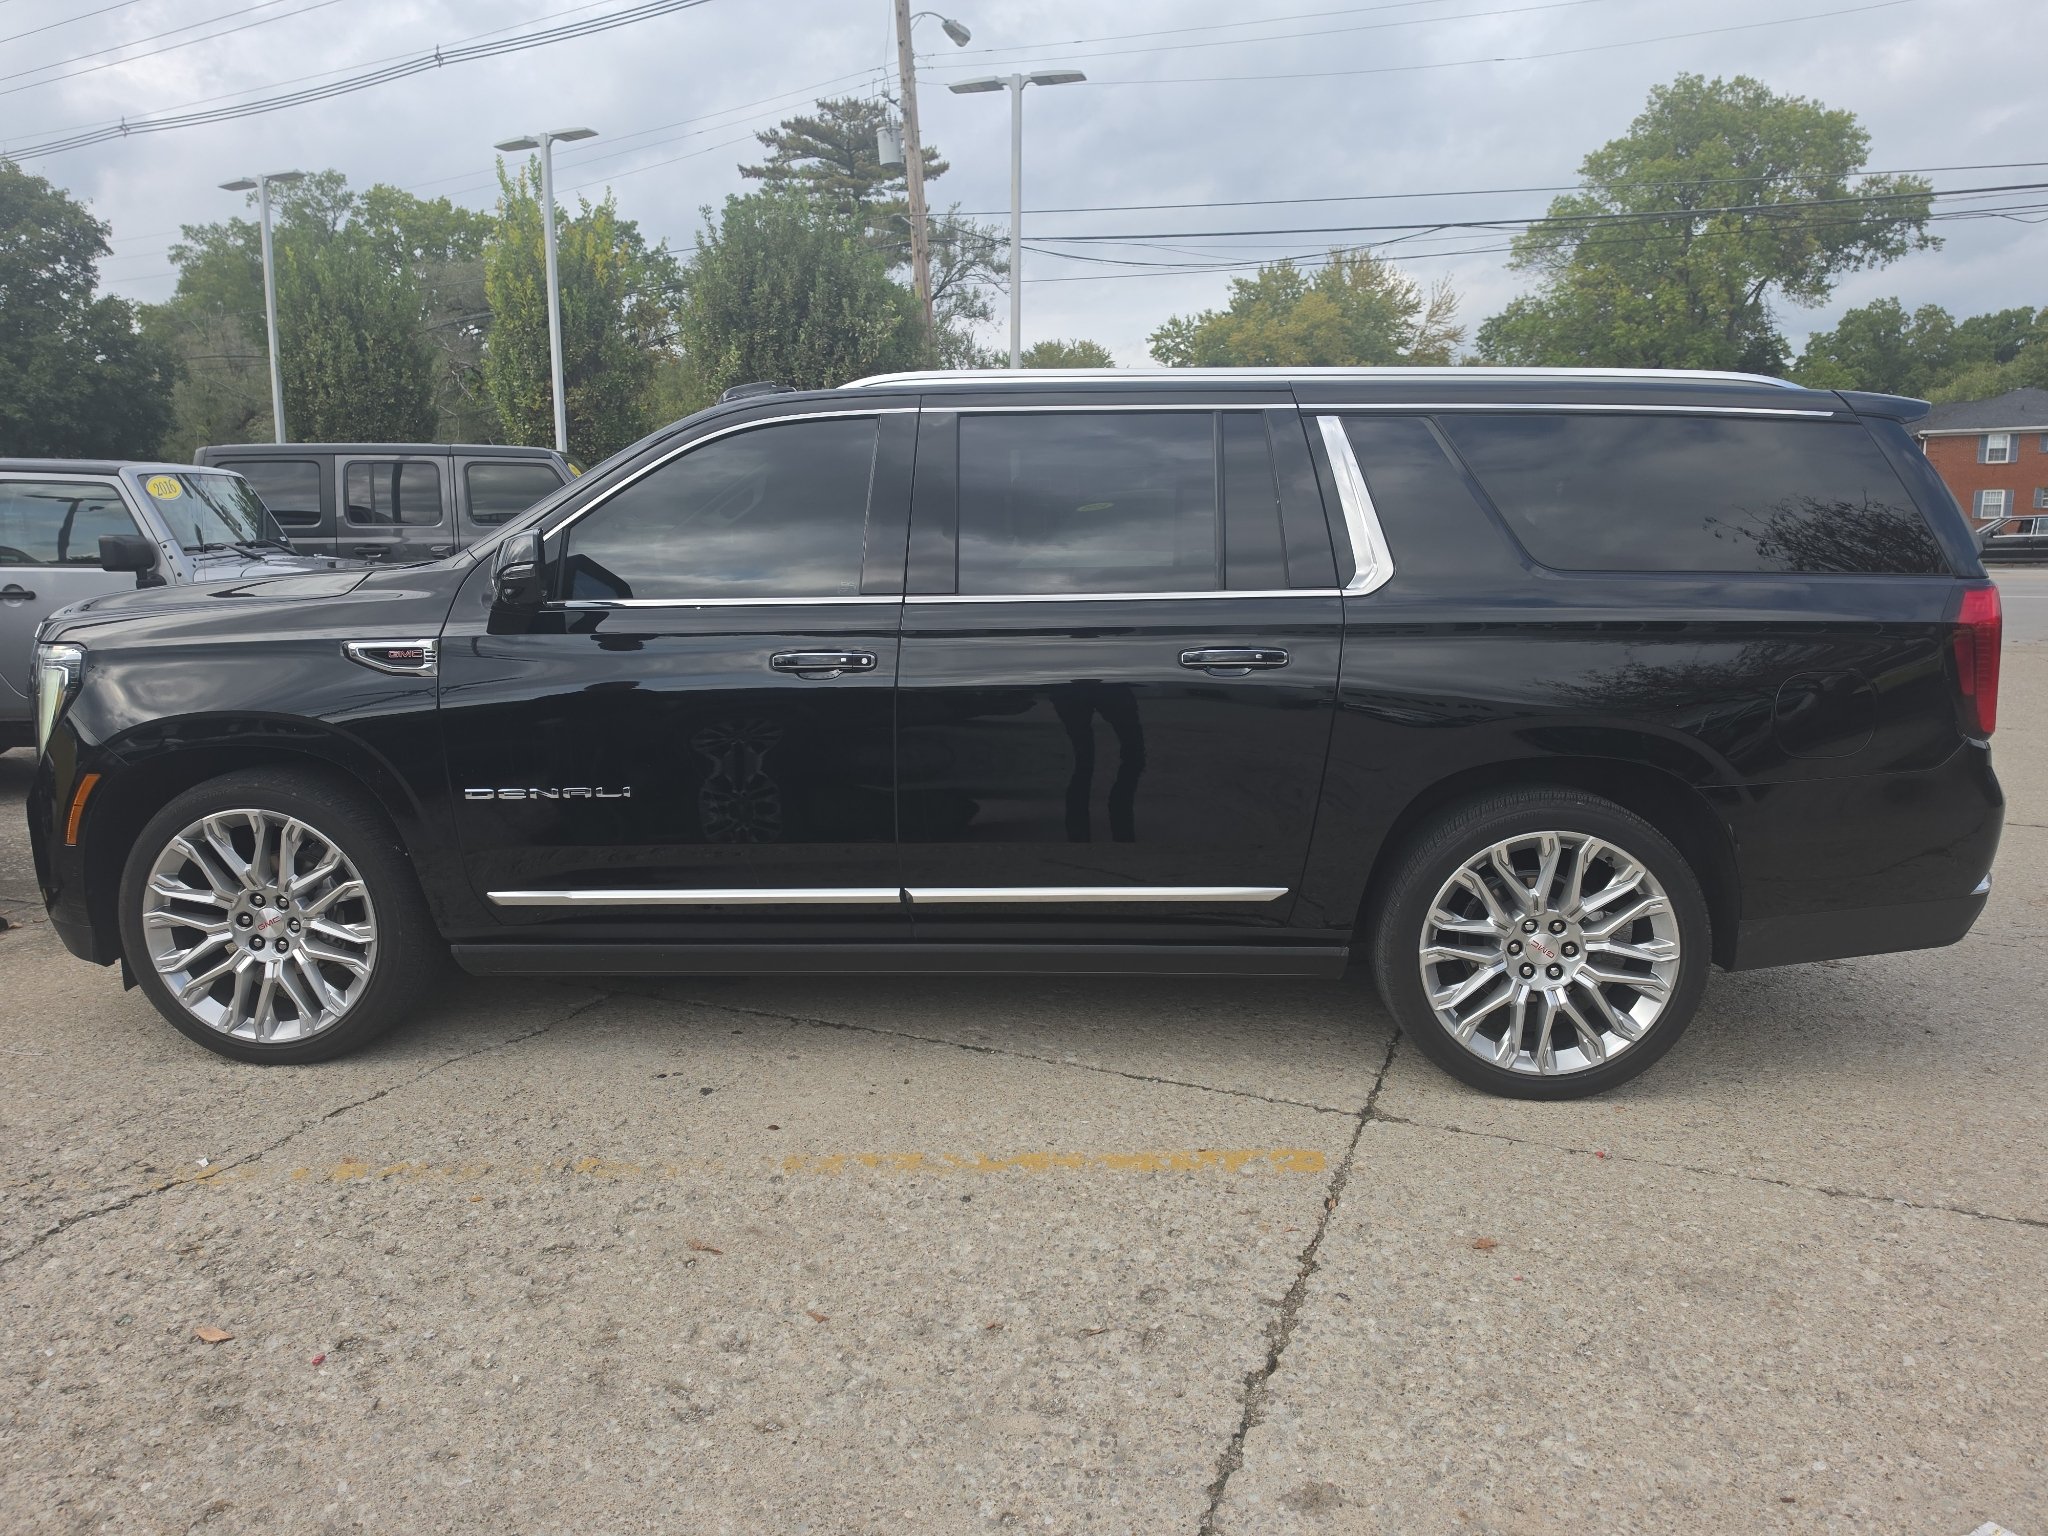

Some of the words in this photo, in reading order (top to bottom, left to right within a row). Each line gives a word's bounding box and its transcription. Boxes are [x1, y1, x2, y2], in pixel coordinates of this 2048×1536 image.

[153, 479, 177, 496] 2016
[388, 650, 422, 659] GMC
[464, 786, 631, 800] DENALI
[257, 916, 281, 931] GMC
[1530, 939, 1555, 959] GMC
